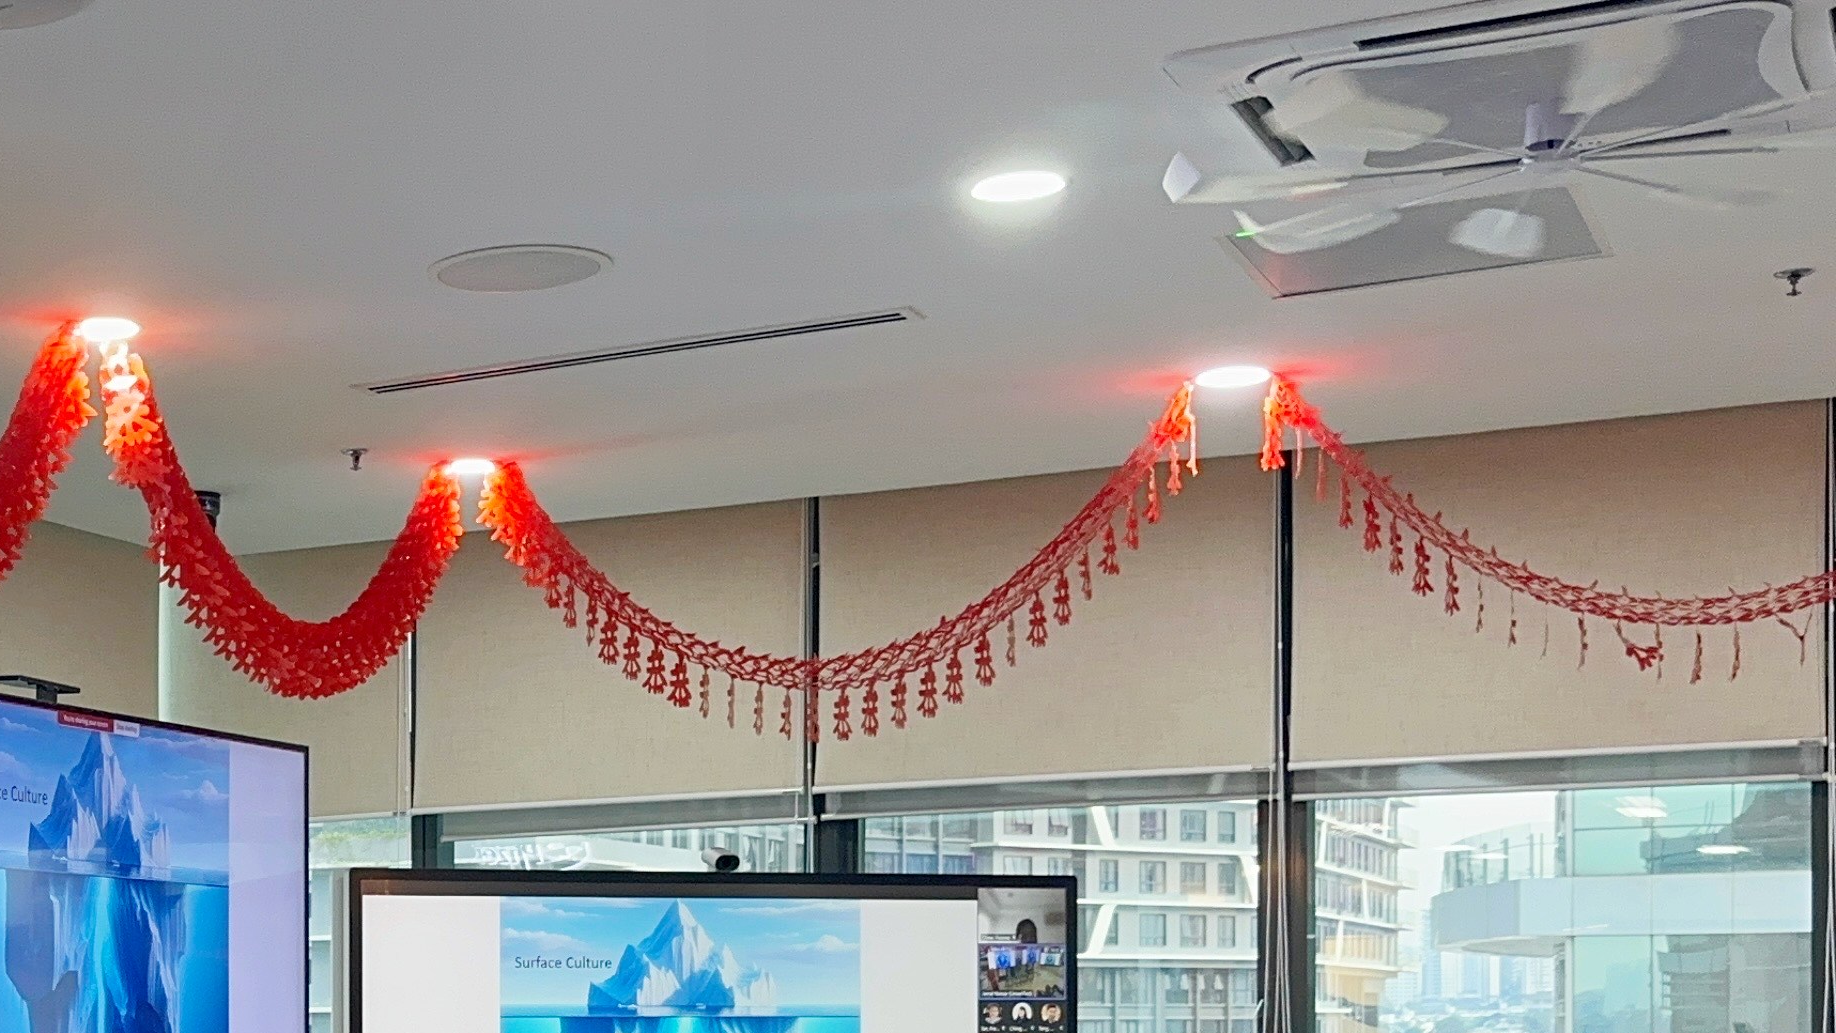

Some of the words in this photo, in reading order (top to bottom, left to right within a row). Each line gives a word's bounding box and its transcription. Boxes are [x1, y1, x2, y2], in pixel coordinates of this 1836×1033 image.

[11, 785, 49, 805] Culture
[514, 955, 562, 969] Surface
[565, 955, 613, 969] Culture
